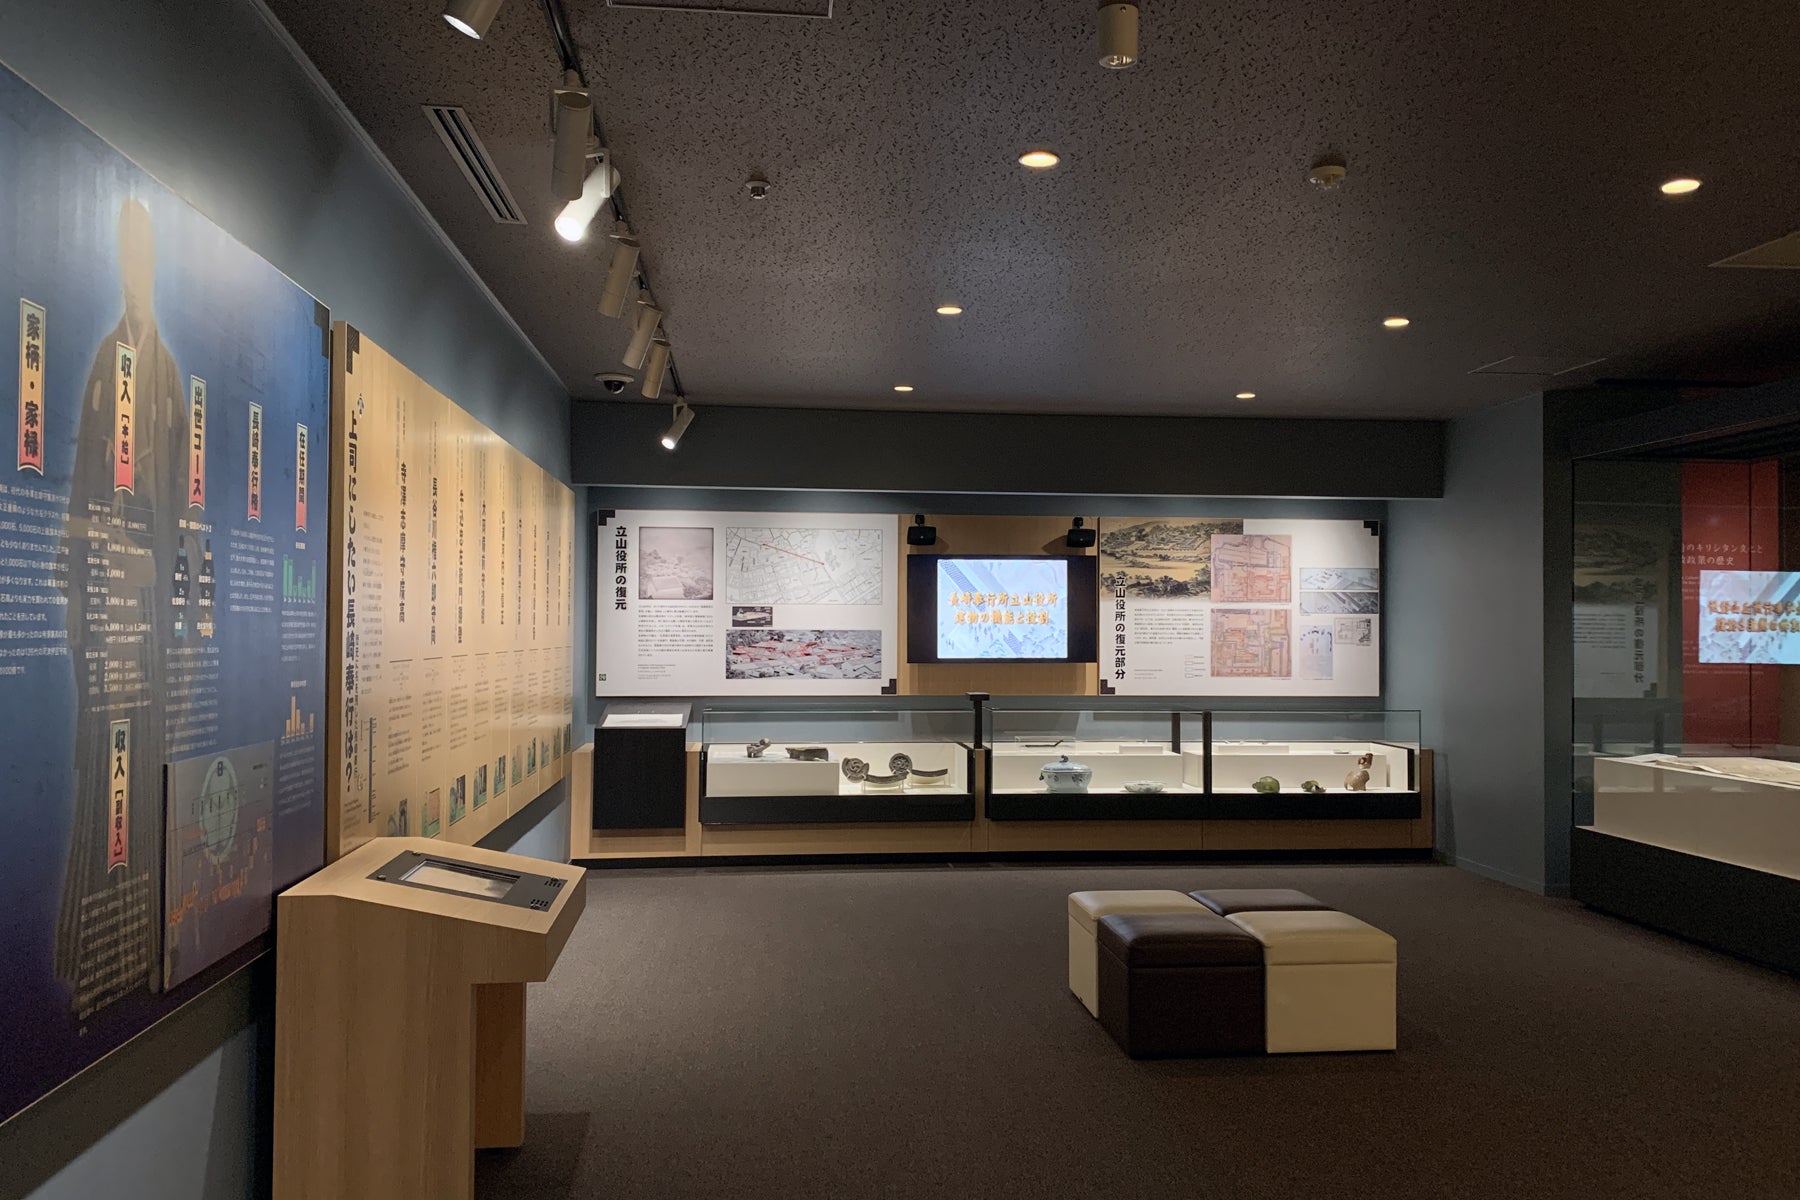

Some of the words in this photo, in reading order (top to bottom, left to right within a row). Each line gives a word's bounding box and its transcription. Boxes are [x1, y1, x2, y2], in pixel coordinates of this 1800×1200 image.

[23, 313, 40, 458] 家柄・家禄
[193, 386, 202, 496] 出世コース
[615, 525, 627, 611] 立山役所の復元
[1682, 543, 1763, 554] のキリシタン文化と
[949, 591, 1058, 607] 長崎奉行所立山役所
[954, 609, 1050, 625] 建物の機能と役割
[1115, 576, 1126, 680] 立山役所の復元部分
